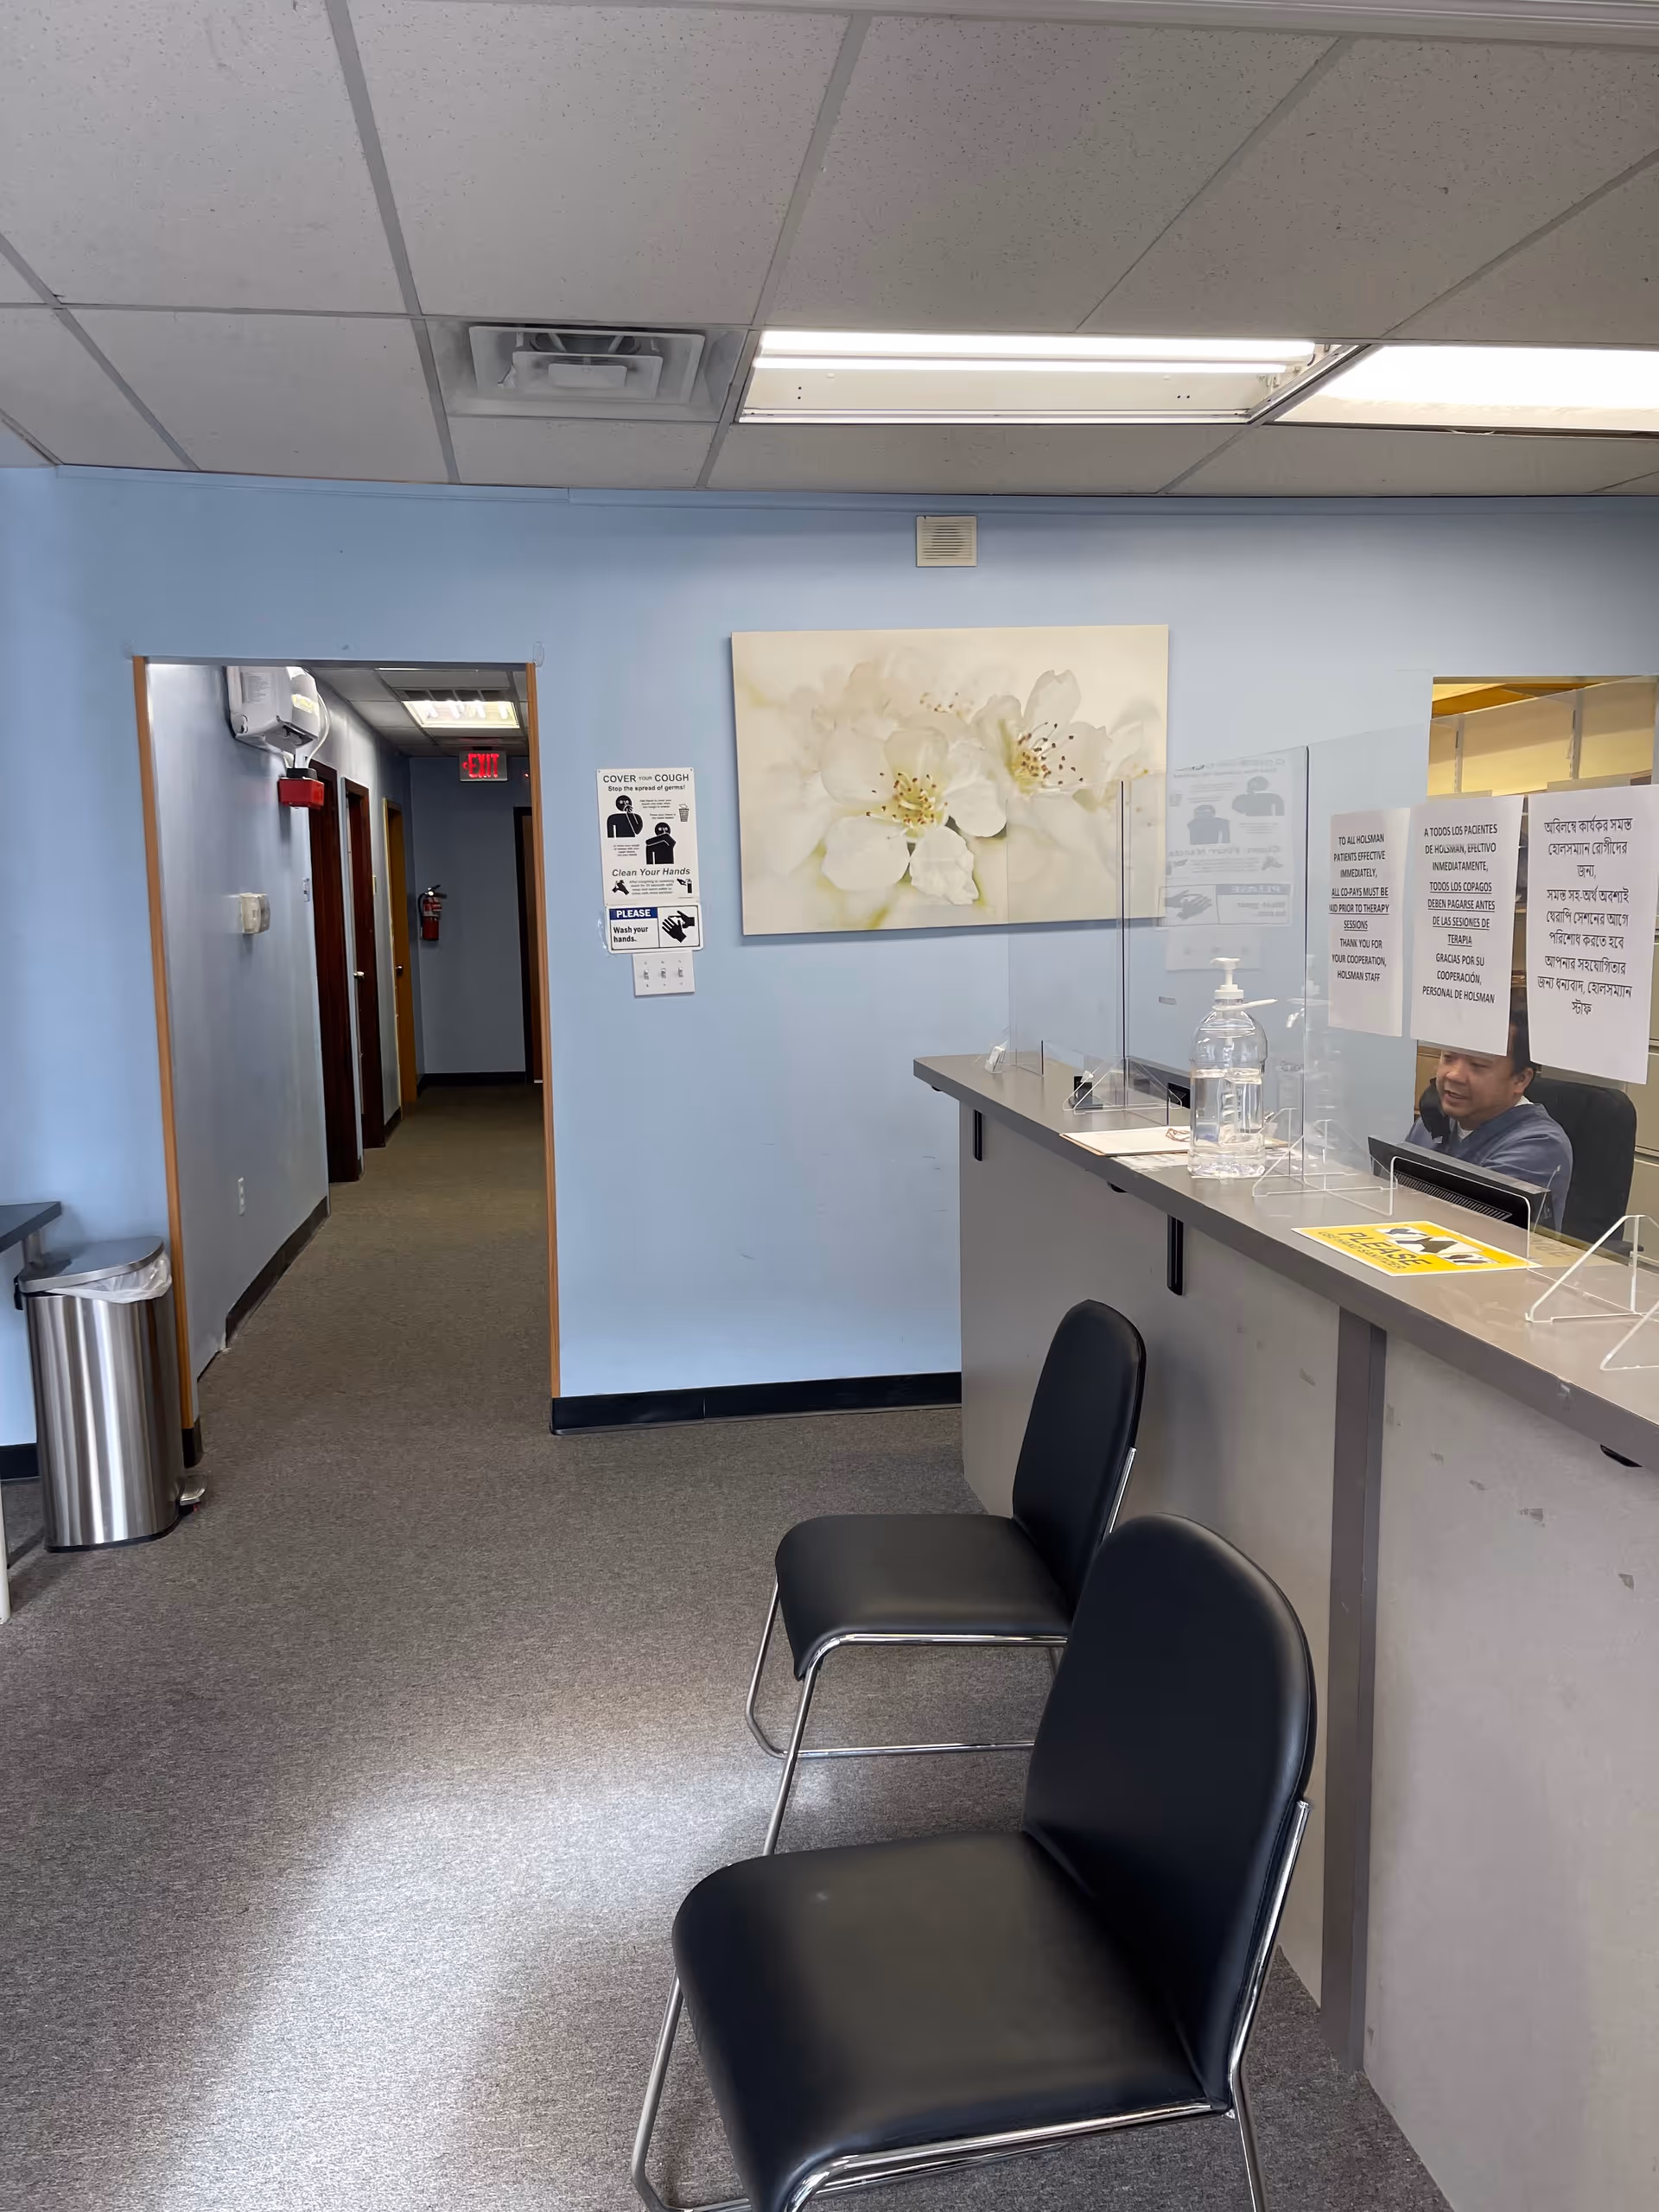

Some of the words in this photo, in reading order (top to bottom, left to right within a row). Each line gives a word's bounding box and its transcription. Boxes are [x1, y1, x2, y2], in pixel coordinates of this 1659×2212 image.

[467, 753, 500, 779] EXIT
[602, 774, 637, 783] COVER
[654, 773, 690, 782] COUGH
[1424, 828, 1428, 836] A
[1429, 826, 1451, 836] TODOS
[1452, 825, 1463, 836] LOS
[1464, 823, 1497, 835] PACIENTES
[1578, 815, 1608, 833] কার্যকর
[1610, 817, 1633, 831] সমস্ত
[1338, 836, 1346, 846] TO
[1347, 836, 1356, 845] ALL
[1357, 833, 1384, 844] HOLSMAN
[1425, 844, 1433, 854] DE
[1434, 843, 1466, 855] HOLSMAN,
[1467, 842, 1497, 853] EFECTIVO
[1333, 852, 1357, 862] PATIENTS
[1357, 850, 1386, 861] EFFECTIVE
[612, 868, 637, 877] Clean
[1432, 861, 1489, 873] INMEDIATAMENTE,
[1340, 868, 1378, 879] IMMEDIATELY,
[1332, 887, 1340, 897] ALL
[1340, 887, 1363, 897] CO-PAYS
[1363, 887, 1380, 896] MUST
[1380, 887, 1389, 896] BE
[1429, 881, 1449, 891] TODOS
[1451, 882, 1462, 891] LOS
[1463, 881, 1492, 892] COPAGOS
[1338, 904, 1355, 912] PRIOR
[1355, 904, 1363, 913] TO
[1363, 904, 1390, 913] THERAPY
[1427, 899, 1446, 908] DEBEN
[1447, 899, 1474, 909] PAGARSE
[1475, 900, 1496, 910] ANTES
[616, 909, 652, 918] PLEASE
[1344, 919, 1369, 930] SESSIONS
[1433, 916, 1440, 925] DE
[1441, 917, 1452, 926] LAS
[1452, 918, 1480, 927] SESIONES
[1481, 918, 1491, 928] DE
[1606, 913, 1629, 927] আগে
[1339, 938, 1358, 948] THANK
[1358, 938, 1370, 949] YOU
[1371, 939, 1382, 949] FOR
[1447, 934, 1472, 944] TERAPIA
[1582, 934, 1606, 947] করতে
[1608, 936, 1624, 950] হবে
[1332, 954, 1346, 963] YOUR
[1346, 955, 1387, 968] COOPERATION,
[1435, 953, 1460, 964] GRACIAS
[1462, 955, 1475, 965] POR
[1476, 956, 1484, 966] SU
[1545, 955, 1576, 969] আপনার
[1337, 970, 1363, 981] HOLSMAN
[1364, 972, 1381, 982] STAFF
[1437, 970, 1482, 985] COOPERACIÓN,
[1537, 976, 1554, 988] জন্য
[1422, 985, 1453, 998] PERSONAL
[1454, 989, 1462, 1000] DE
[1464, 990, 1496, 1003] HOLSMAN
[1338, 1232, 1433, 1266] PLEASE
